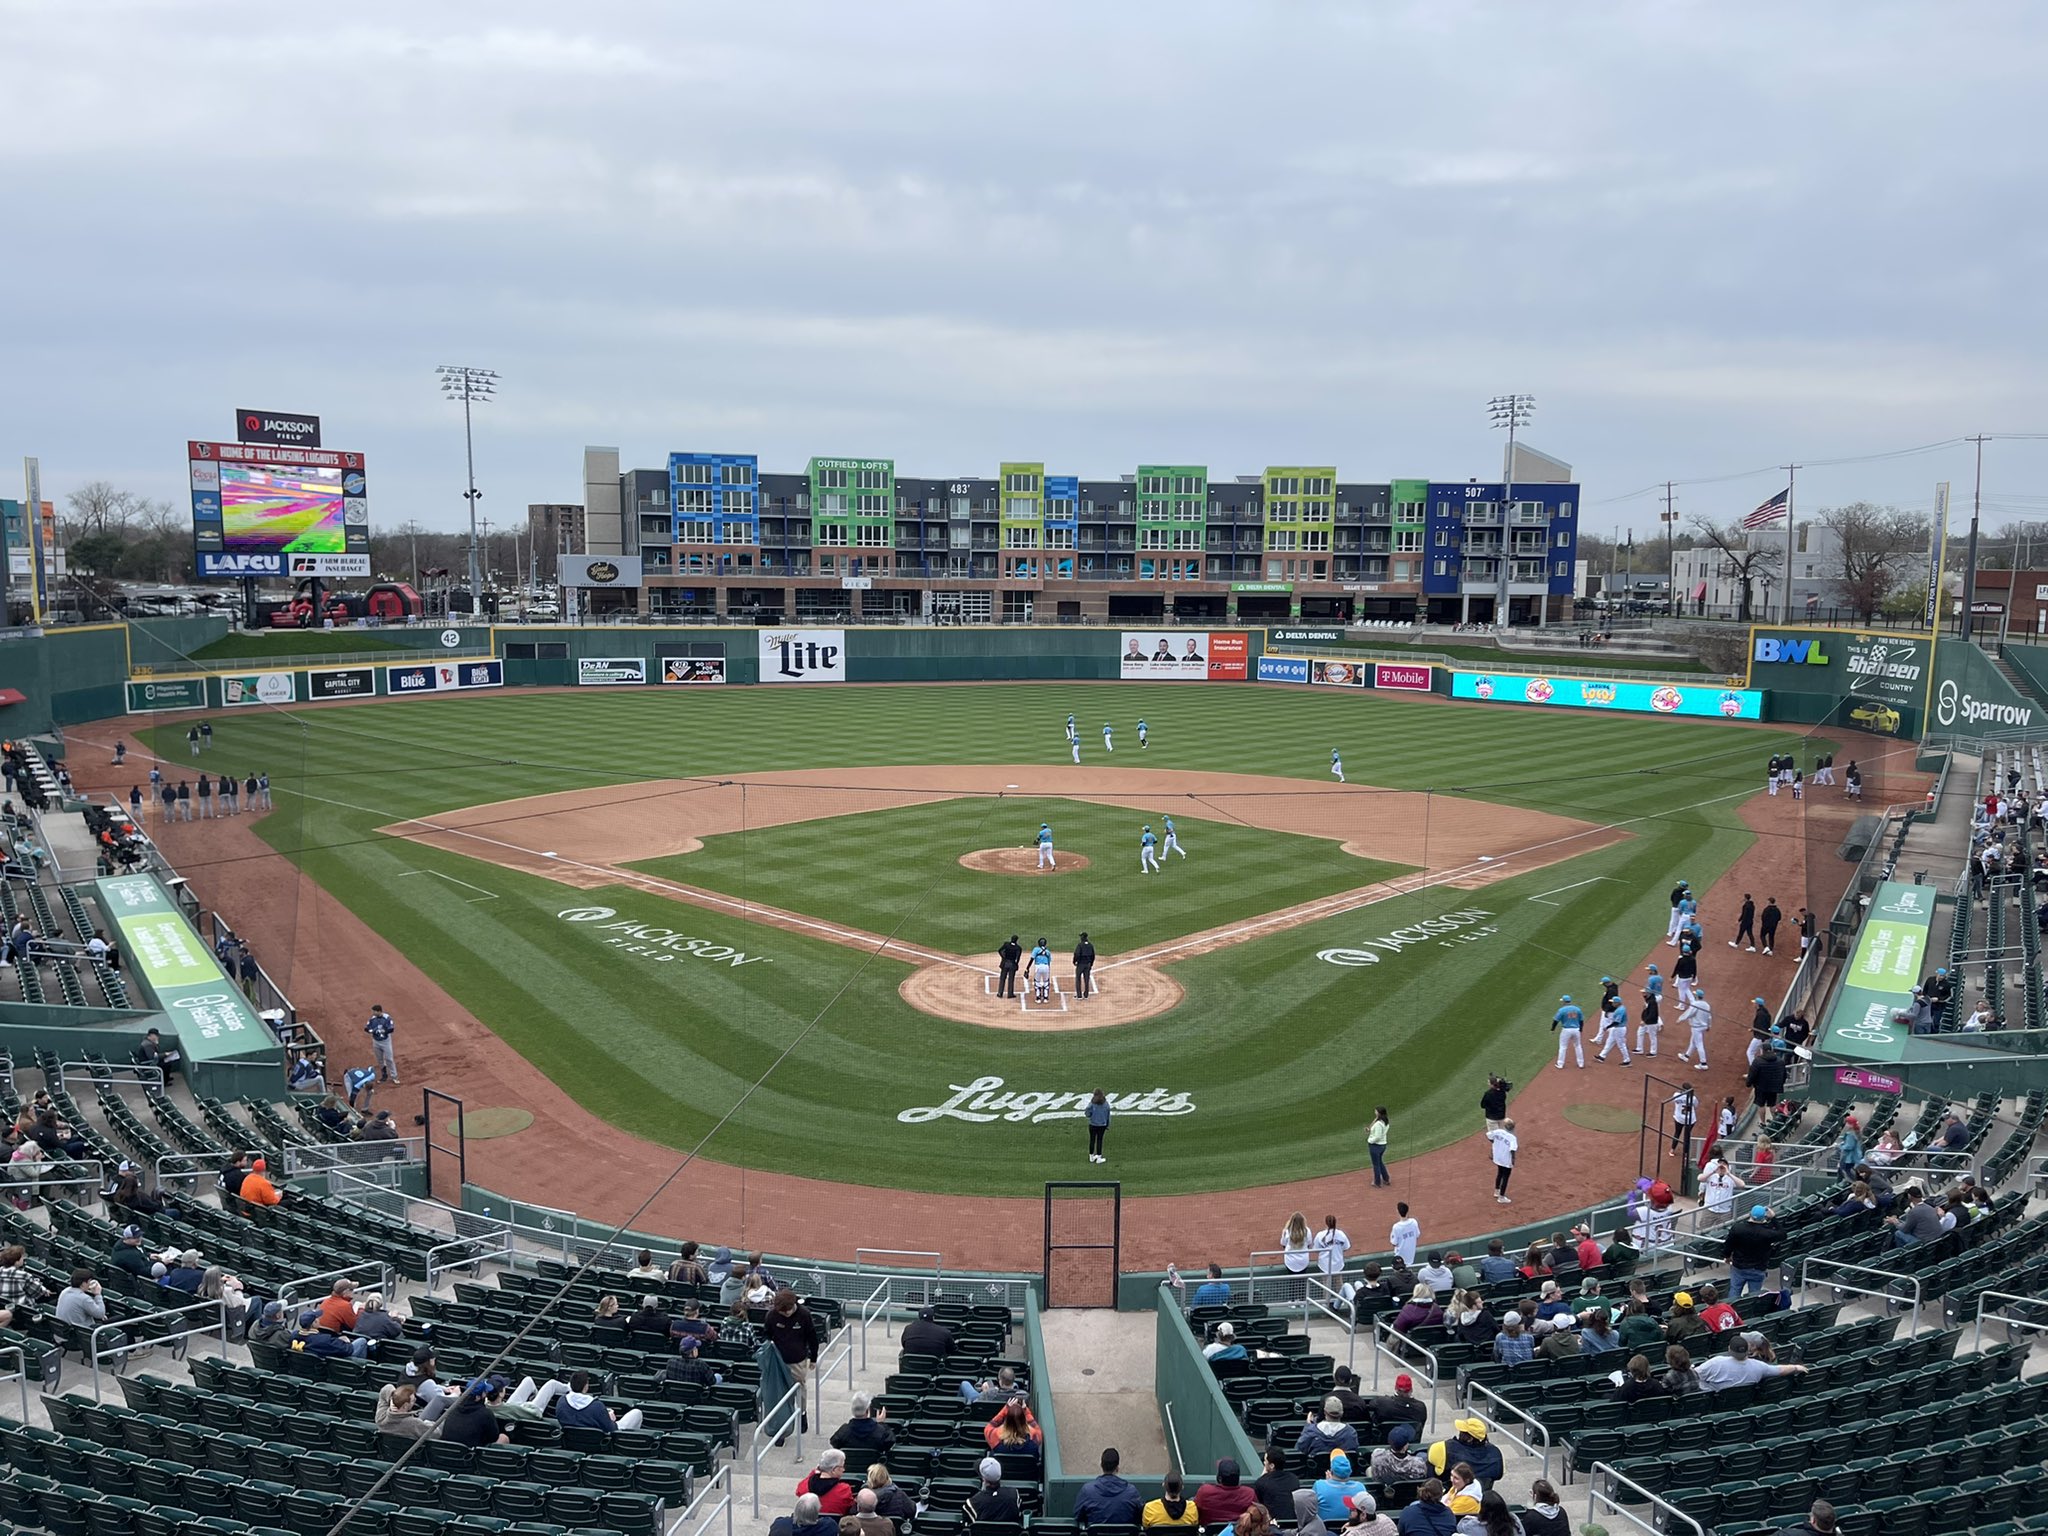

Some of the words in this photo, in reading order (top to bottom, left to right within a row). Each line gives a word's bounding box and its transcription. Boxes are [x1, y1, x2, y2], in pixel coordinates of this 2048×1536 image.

[264, 419, 314, 434] JACKSON
[220, 446, 243, 459] HOME
[244, 447, 255, 460] OF
[256, 448, 271, 461] THE
[272, 449, 305, 463] LANSING
[306, 452, 339, 465] LUGNUTS
[817, 460, 858, 468] OUTFIELD
[860, 461, 889, 470] LOFTS
[205, 555, 281, 570] LAFCU
[443, 634, 457, 645] 42
[764, 632, 799, 650] Miller
[1308, 632, 1337, 640] DENTAL
[777, 640, 838, 678] Lite
[1755, 638, 1829, 665] BWL
[1846, 655, 1920, 680] Shaheen
[325, 679, 346, 688] CAPITAL
[401, 674, 426, 688] Blue
[1391, 671, 1425, 684] Mobile
[1880, 682, 1914, 692] COUNTRY
[1960, 694, 2031, 726] Sparrow
[1363, 906, 1497, 953] JACKSON
[1438, 924, 1499, 948] FIELD
[594, 919, 764, 967] JACKSON
[602, 938, 675, 961] FIELD
[189, 1006, 216, 1024] Health
[213, 1003, 244, 1030] Physicians
[1856, 1003, 1893, 1030] Sparrow
[897, 1076, 1196, 1123] Lugnuts
[291, 1339, 306, 1352] M
